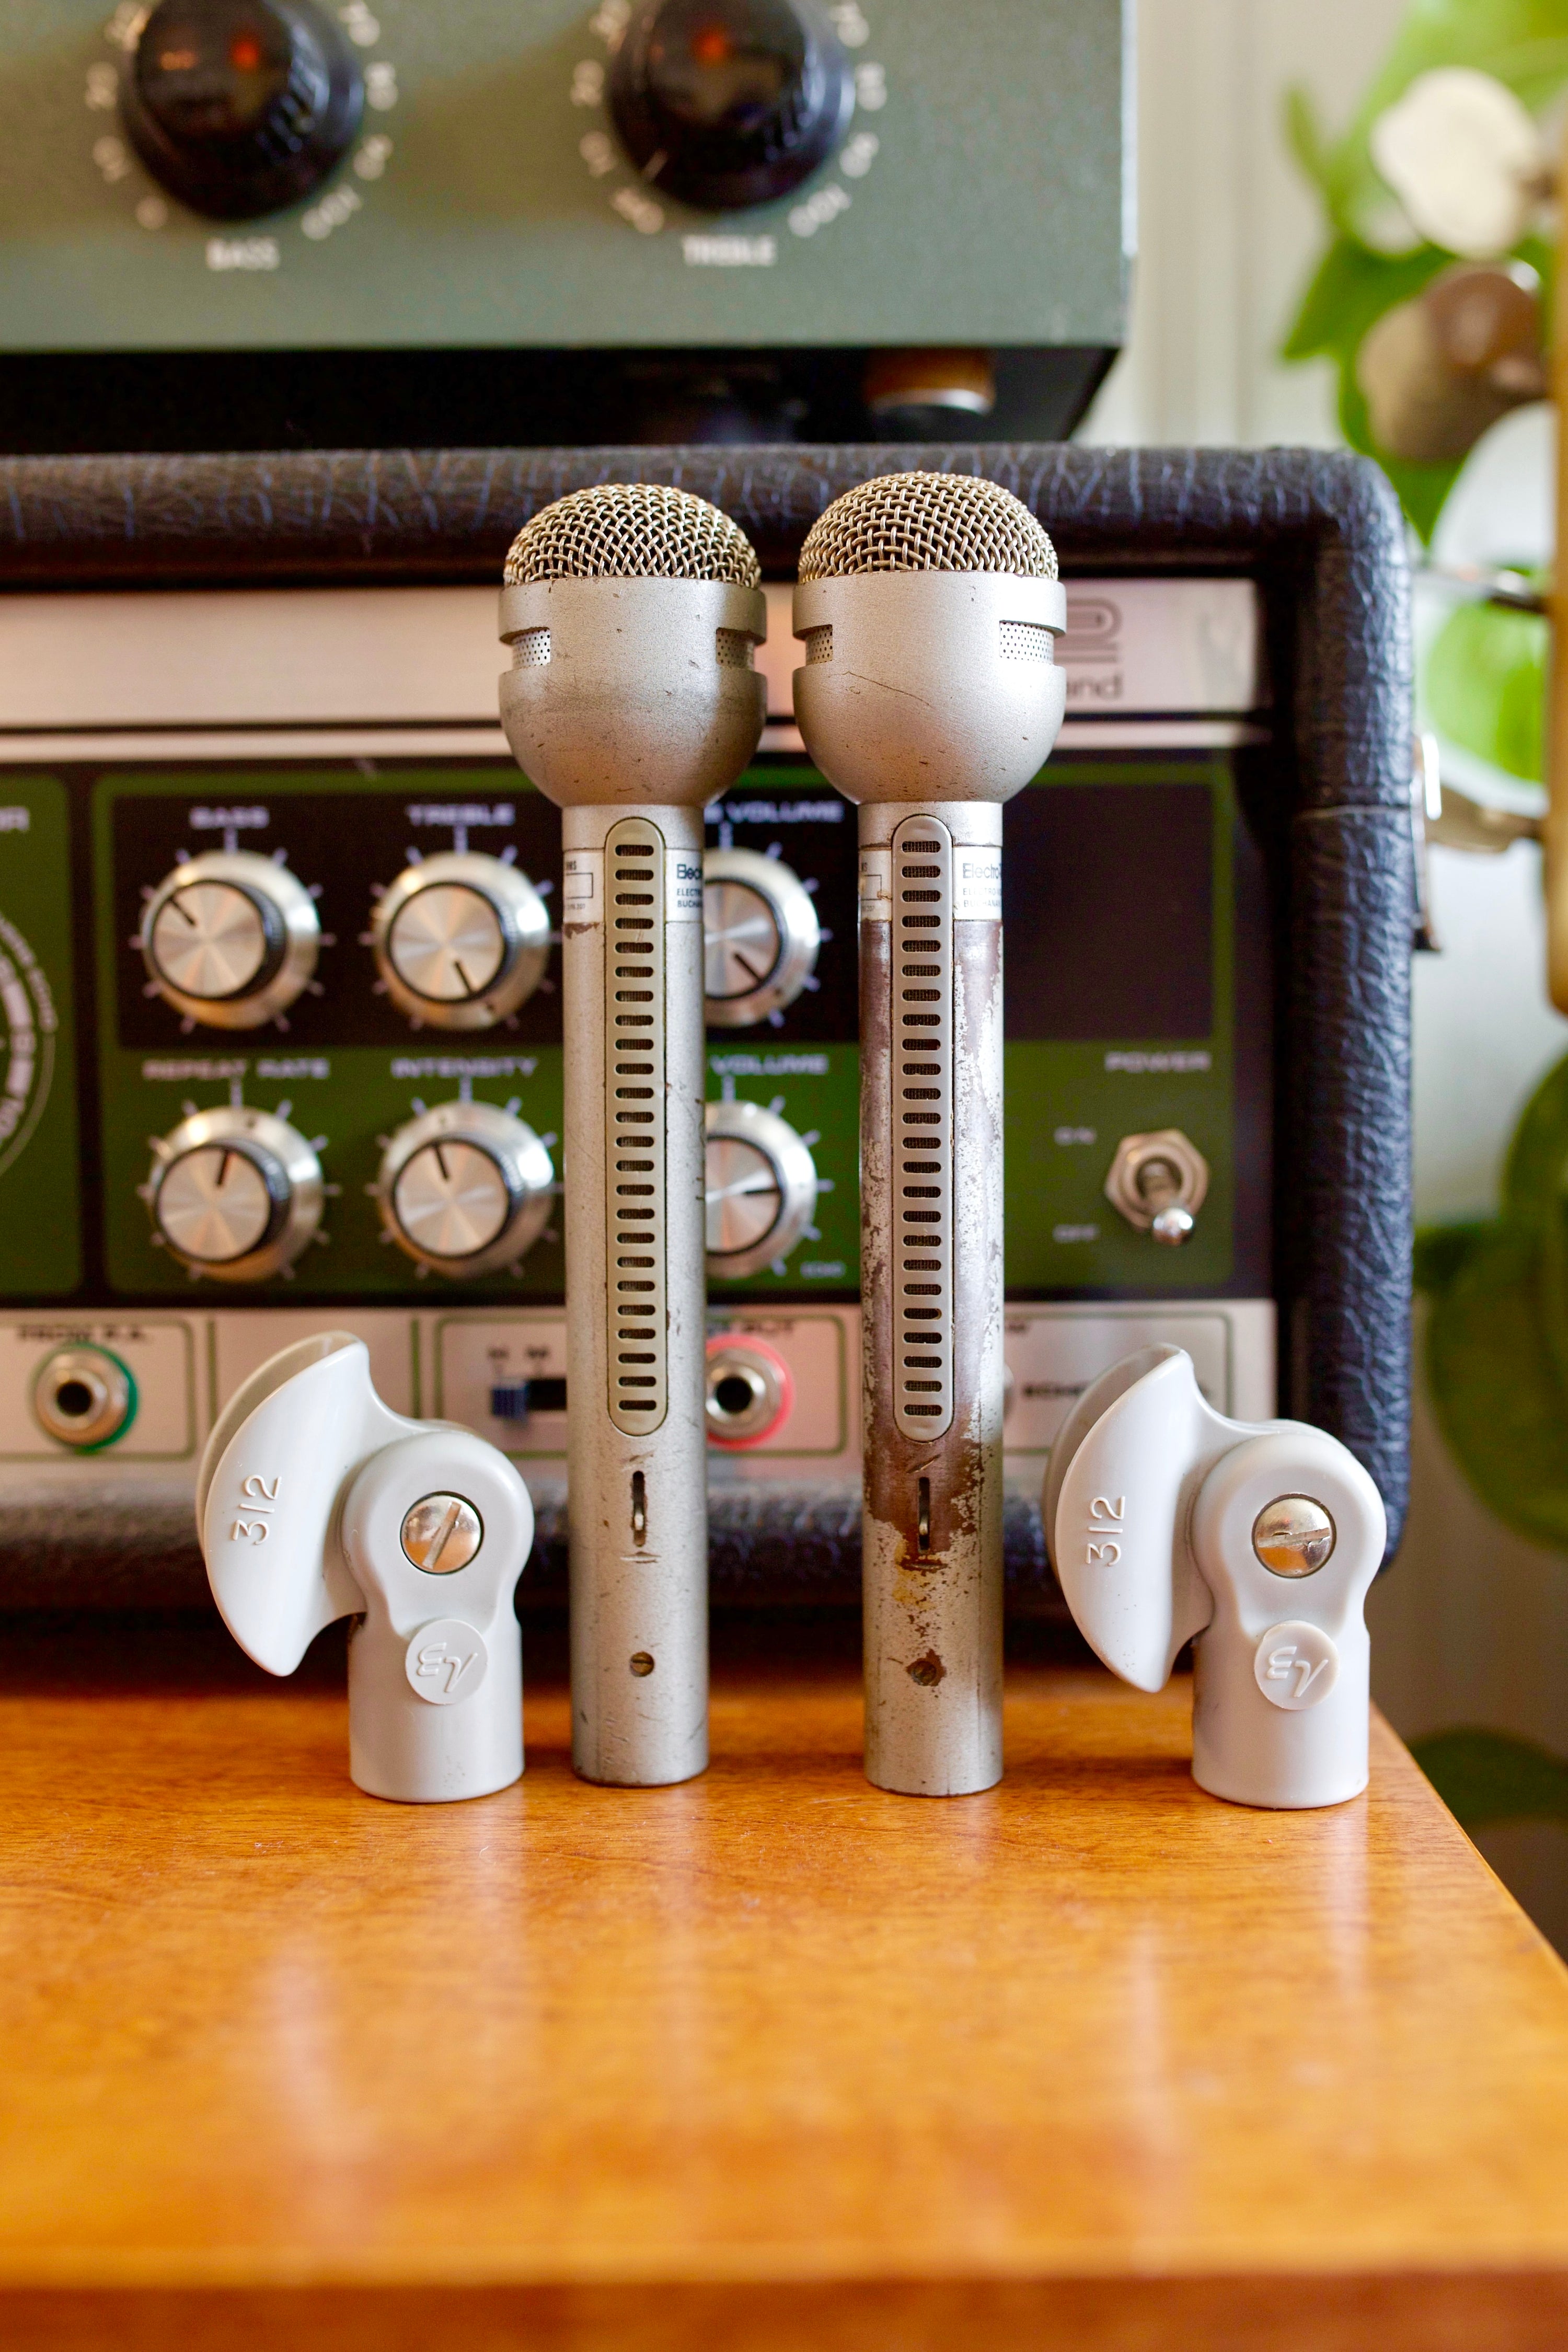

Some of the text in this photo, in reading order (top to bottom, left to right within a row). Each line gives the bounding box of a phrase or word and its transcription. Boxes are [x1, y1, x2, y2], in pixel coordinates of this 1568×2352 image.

[190, 806, 269, 829] BASS
[406, 803, 515, 826] TREBLE
[725, 800, 845, 823] VOLUME
[391, 1057, 538, 1078] INTENSITY
[710, 1054, 829, 1076] VOLUME
[232, 1474, 282, 1546] 312
[1085, 1495, 1126, 1566] 312
